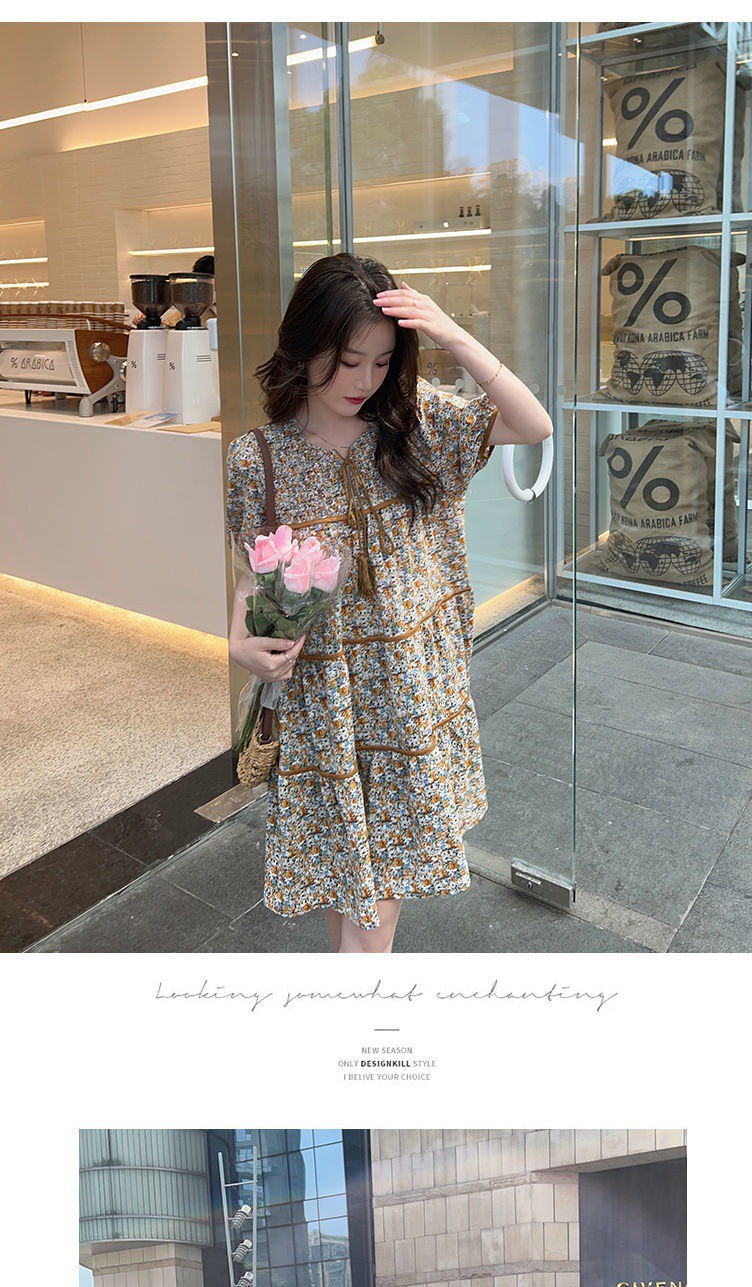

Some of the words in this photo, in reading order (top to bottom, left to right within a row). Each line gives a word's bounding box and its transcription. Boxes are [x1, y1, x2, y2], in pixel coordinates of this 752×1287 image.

[647, 149, 684, 162] ARABICA
[687, 150, 706, 161] FARM
[647, 331, 684, 343] ARABICA
[687, 328, 709, 340] FARM
[21, 358, 54, 370] ARABICA
[640, 518, 677, 529] ARABICA
[679, 512, 698, 526] FARM
